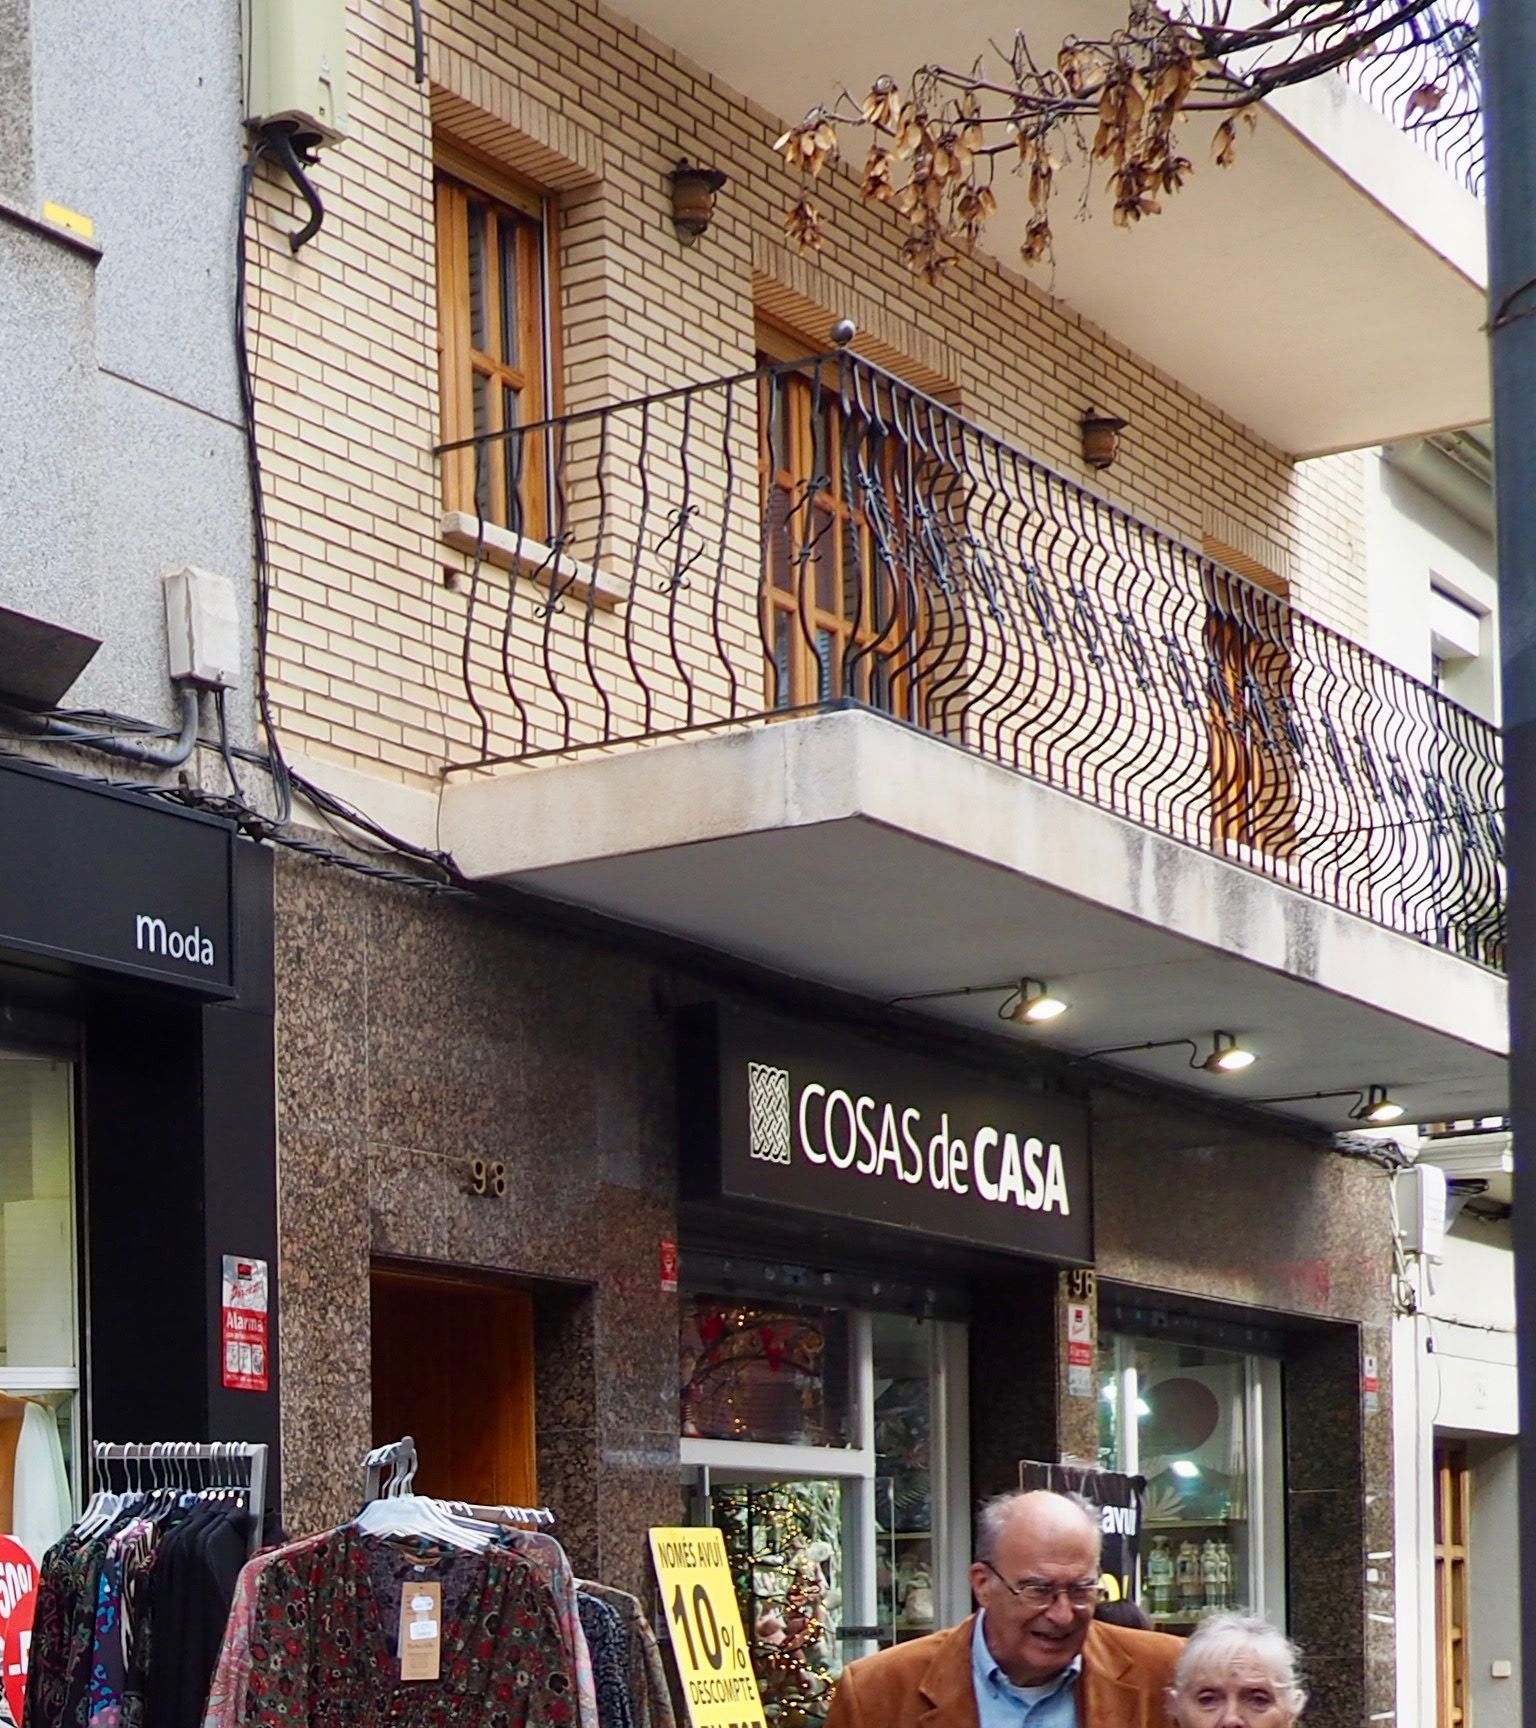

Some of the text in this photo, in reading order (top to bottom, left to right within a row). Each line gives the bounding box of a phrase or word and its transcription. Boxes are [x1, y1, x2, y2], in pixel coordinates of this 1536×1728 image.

[799, 1083, 1070, 1215] COSAS de CASA
[471, 1158, 506, 1197] 98
[226, 1312, 264, 1333] Alarma
[657, 1542, 697, 1569] NOMÉS
[690, 1677, 755, 1704] DESCOMPTE
